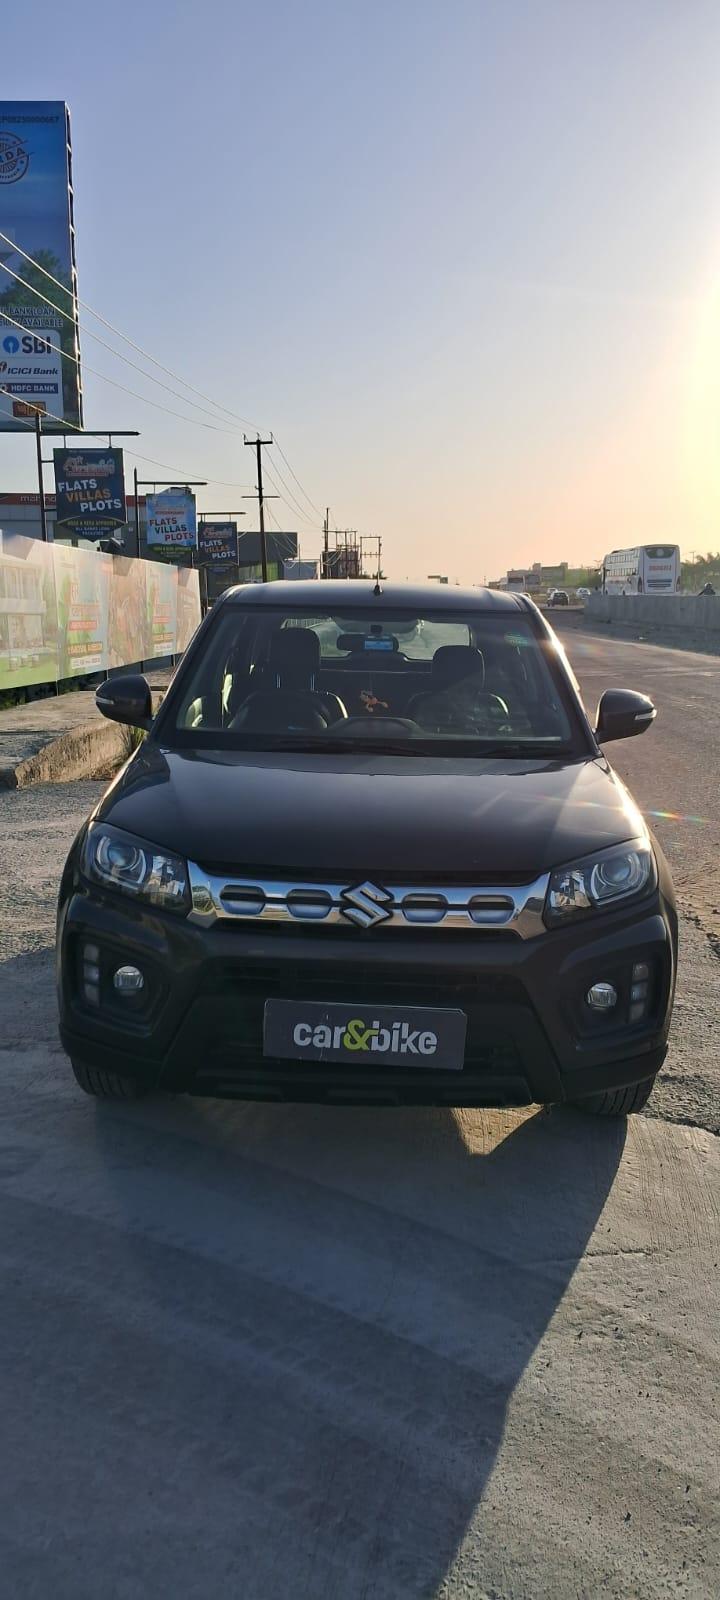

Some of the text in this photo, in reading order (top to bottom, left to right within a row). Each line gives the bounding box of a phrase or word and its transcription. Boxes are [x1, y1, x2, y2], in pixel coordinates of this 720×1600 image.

[21, 336, 52, 354] SBI
[7, 367, 58, 375] ICICI Bank
[58, 479, 98, 492] FLATS
[66, 489, 111, 502] VILLAS
[80, 499, 122, 512] PLOTS
[150, 518, 178, 526] FLATS
[155, 525, 187, 534] VILLAS
[165, 533, 194, 542] PLOTS
[200, 540, 223, 548] FLATS
[212, 551, 236, 559] PLOTS
[293, 1018, 439, 1055] car&bike
